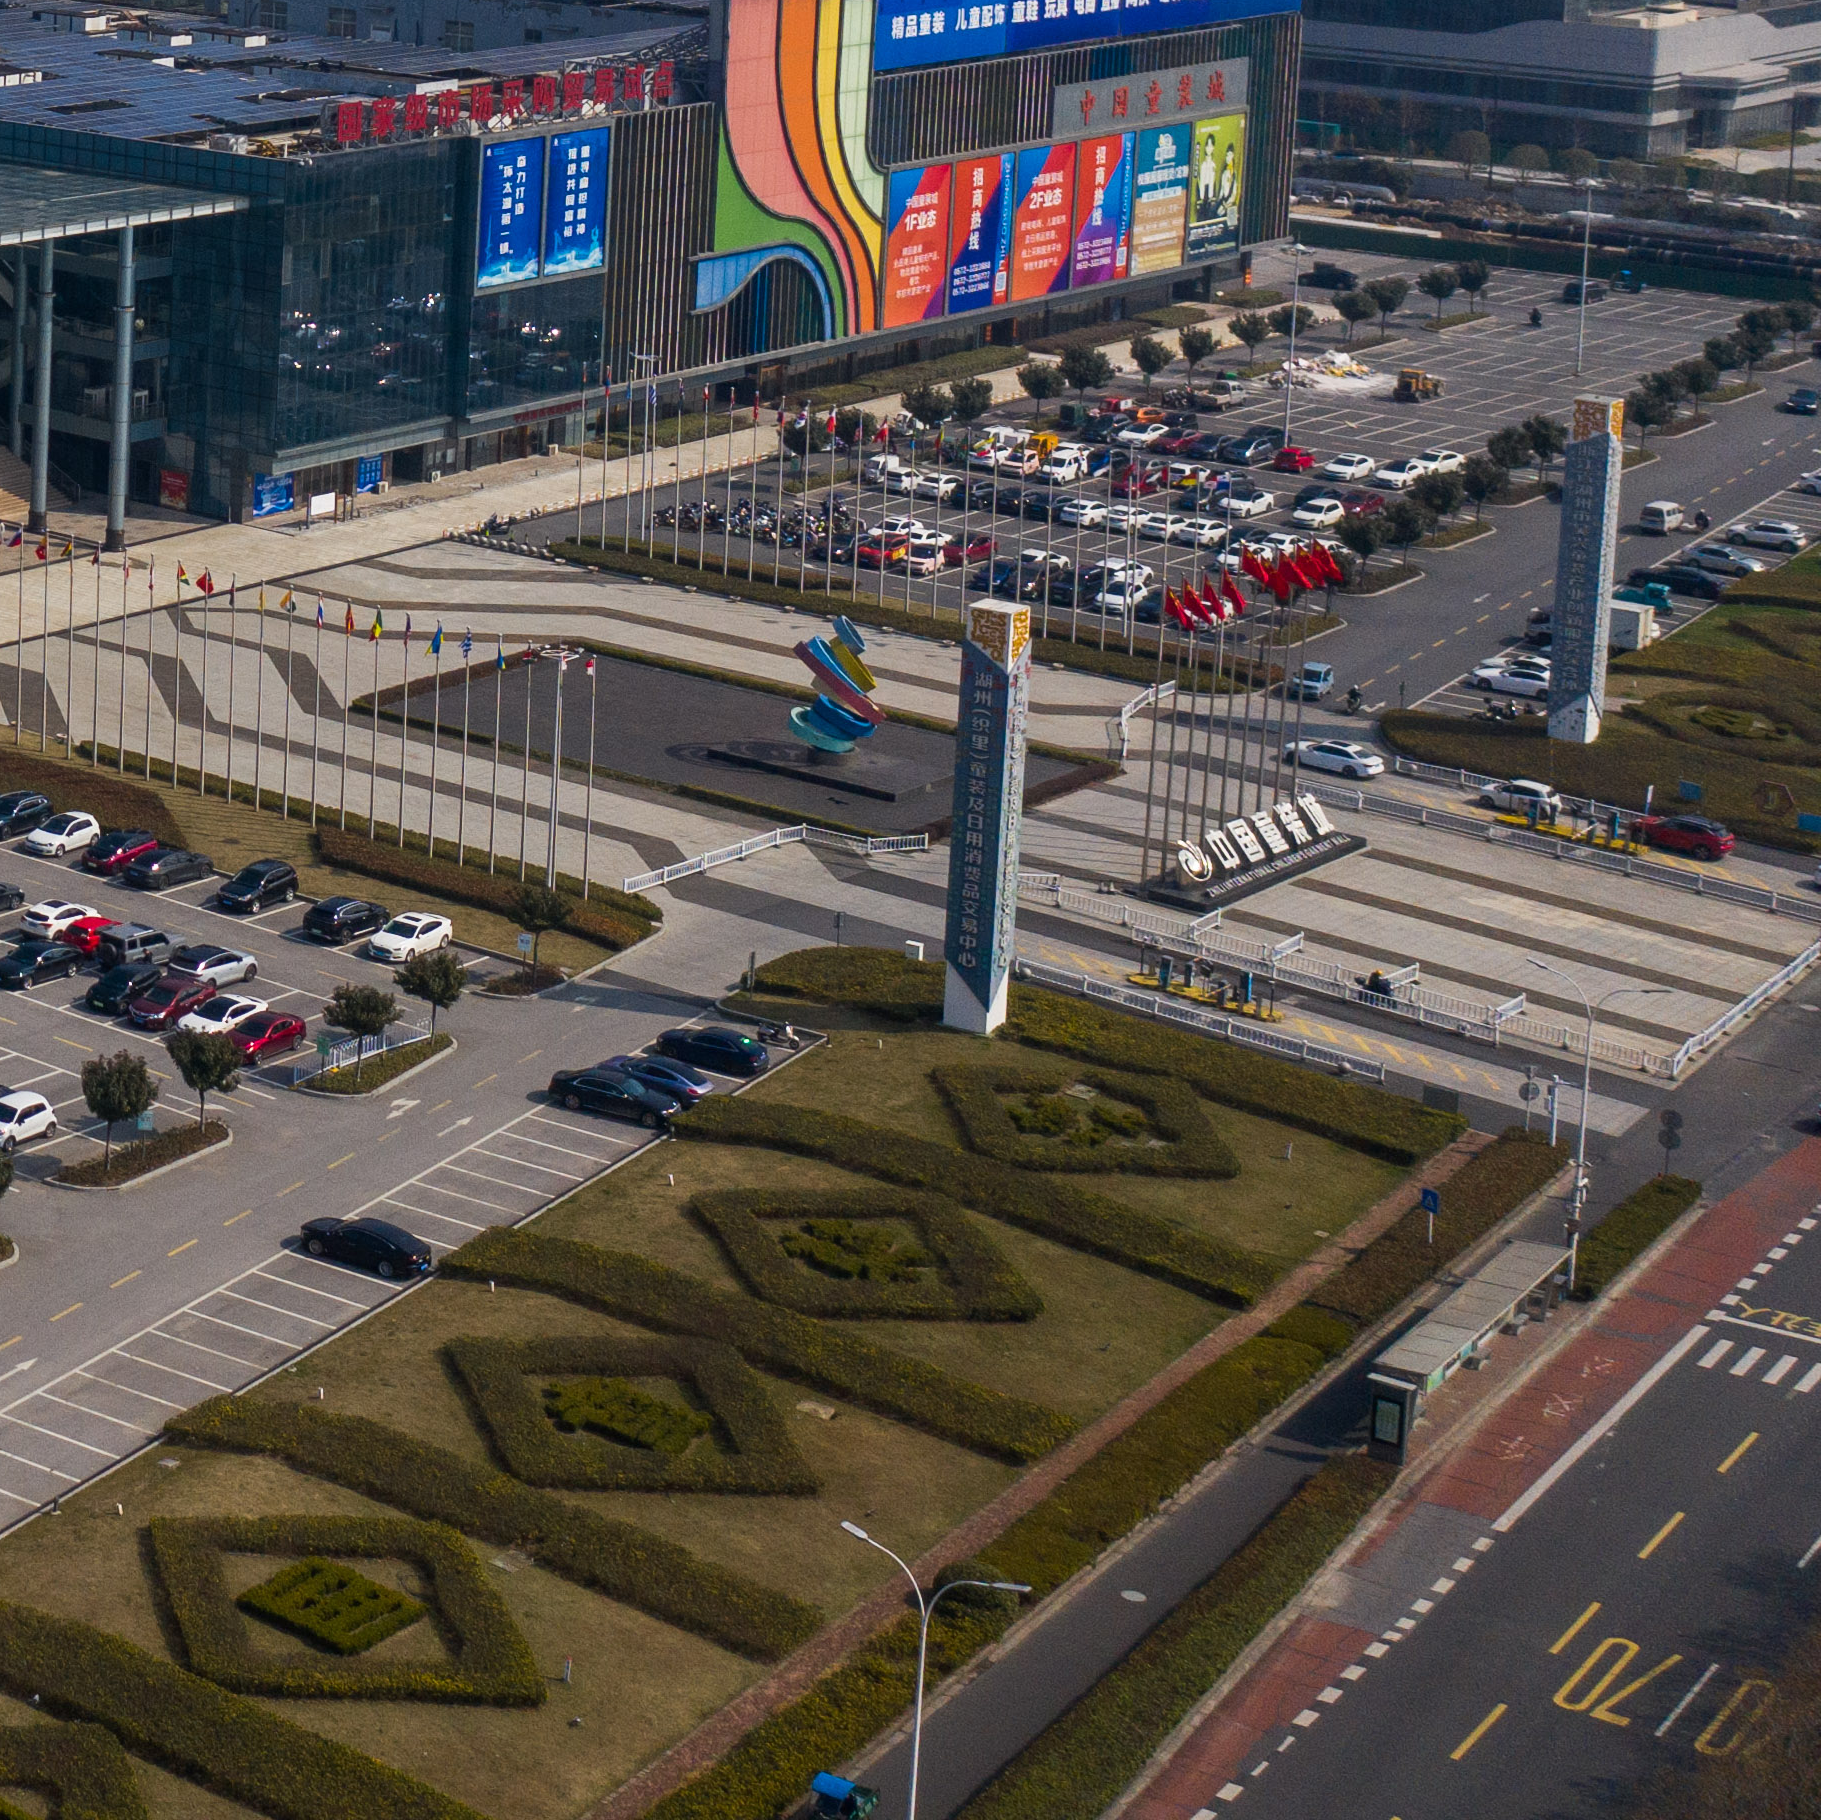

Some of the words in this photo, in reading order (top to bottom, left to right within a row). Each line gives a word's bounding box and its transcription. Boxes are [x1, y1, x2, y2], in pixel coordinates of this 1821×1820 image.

[891, 12, 945, 40] 精品童装
[955, 3, 1005, 31] 儿童配饰
[1012, 0, 1039, 23] 童鞋
[338, 61, 674, 142] 国家级市场采购贸易试点
[1080, 70, 1226, 126] 中国童装城
[1029, 188, 1062, 210] 2F业态
[905, 209, 937, 232] 1F业态
